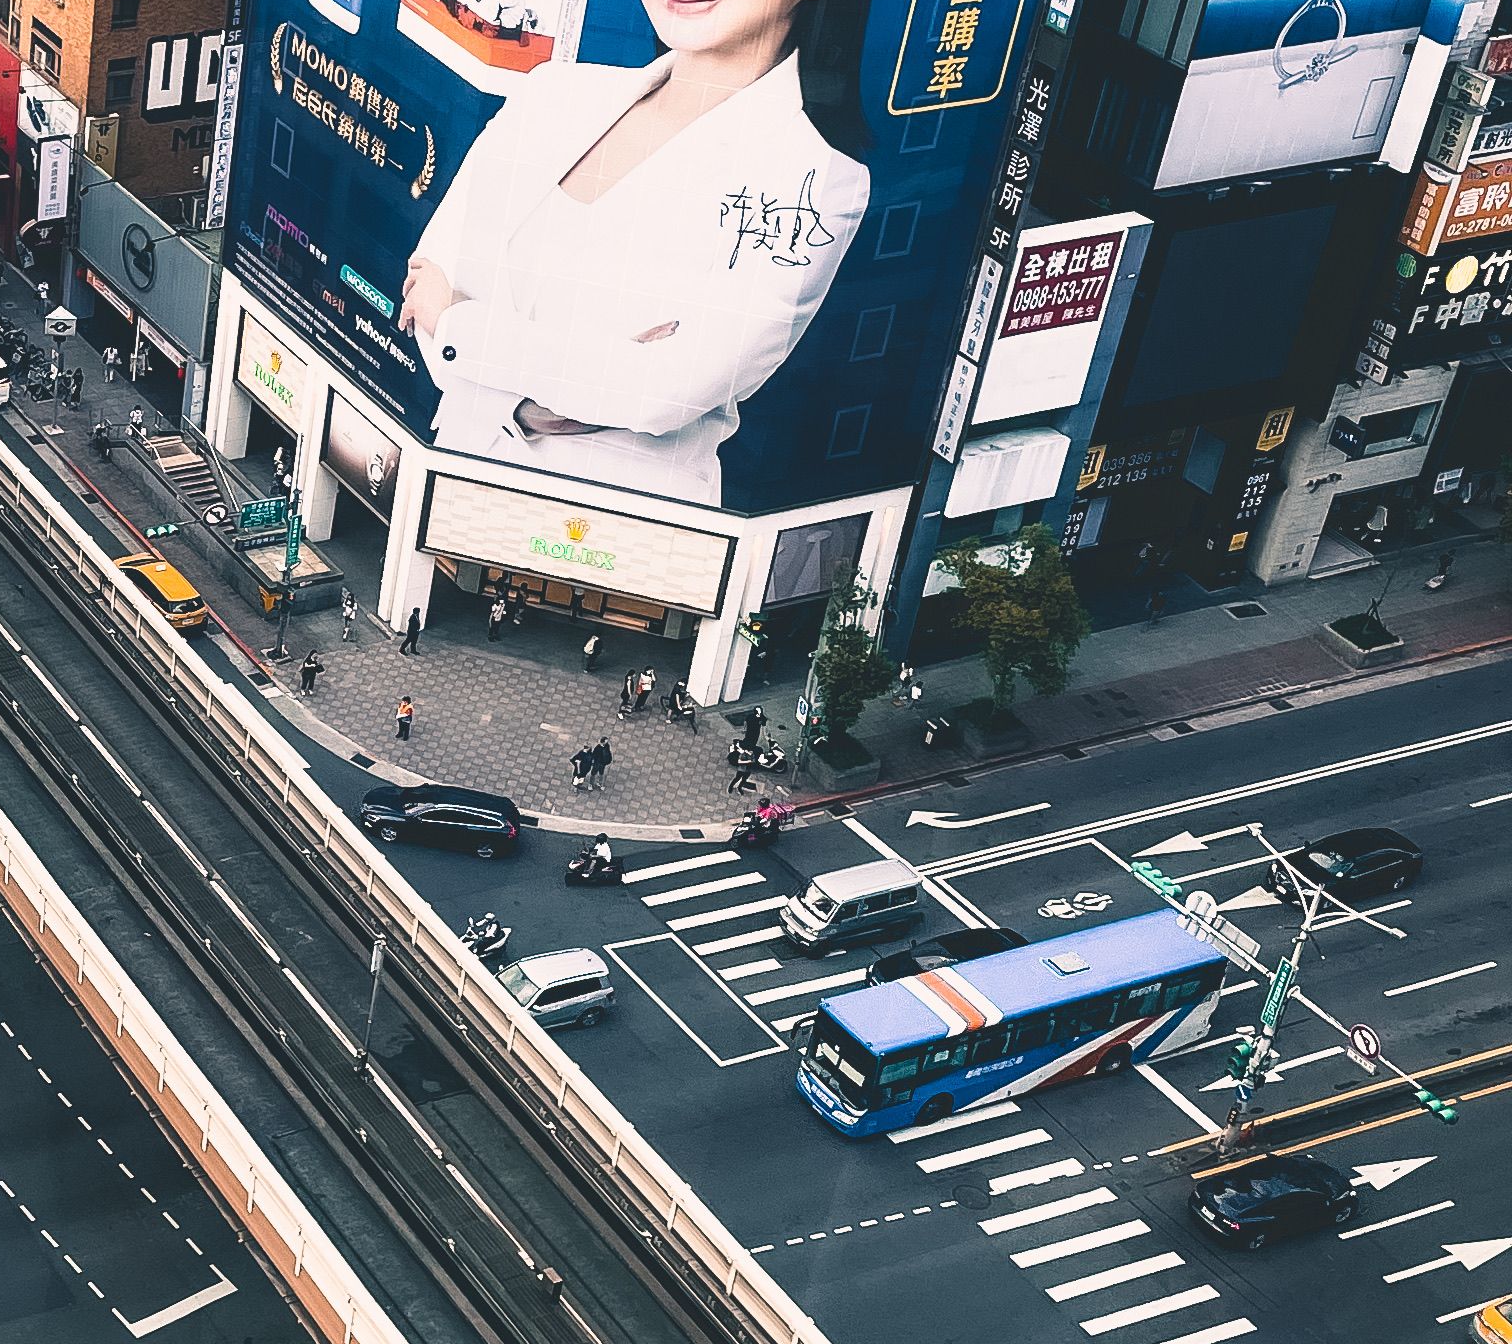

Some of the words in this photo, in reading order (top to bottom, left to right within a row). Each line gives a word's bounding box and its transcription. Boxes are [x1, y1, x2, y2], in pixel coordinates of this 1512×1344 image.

[999, 77, 1050, 217] 光澤診所
[989, 226, 1011, 250] 5F
[1020, 240, 1114, 284] 全棟出租
[1012, 274, 1106, 314] 0988-153-777
[253, 360, 295, 409] ROLEX
[528, 535, 617, 571] ROLEX
